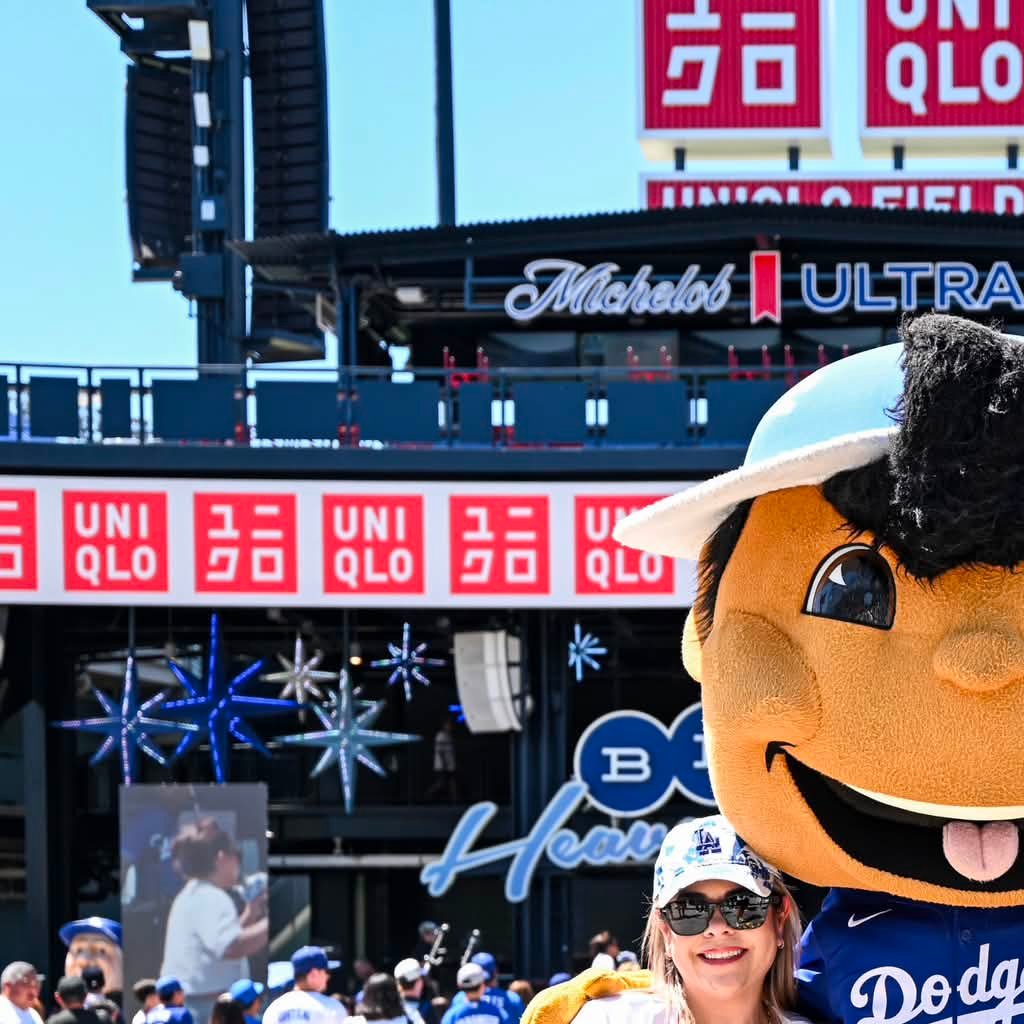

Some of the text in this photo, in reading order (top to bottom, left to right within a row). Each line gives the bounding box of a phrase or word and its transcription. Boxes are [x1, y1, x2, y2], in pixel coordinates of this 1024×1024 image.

[885, 41, 1023, 115] QLO
[504, 258, 735, 320] Michelob
[75, 502, 149, 538] UNI
[333, 506, 405, 541] UNI
[75, 545, 157, 586] QLO
[334, 548, 413, 588] QLO
[586, 548, 664, 589] QLO
[420, 780, 670, 903] Heav
[694, 828, 722, 856] LA
